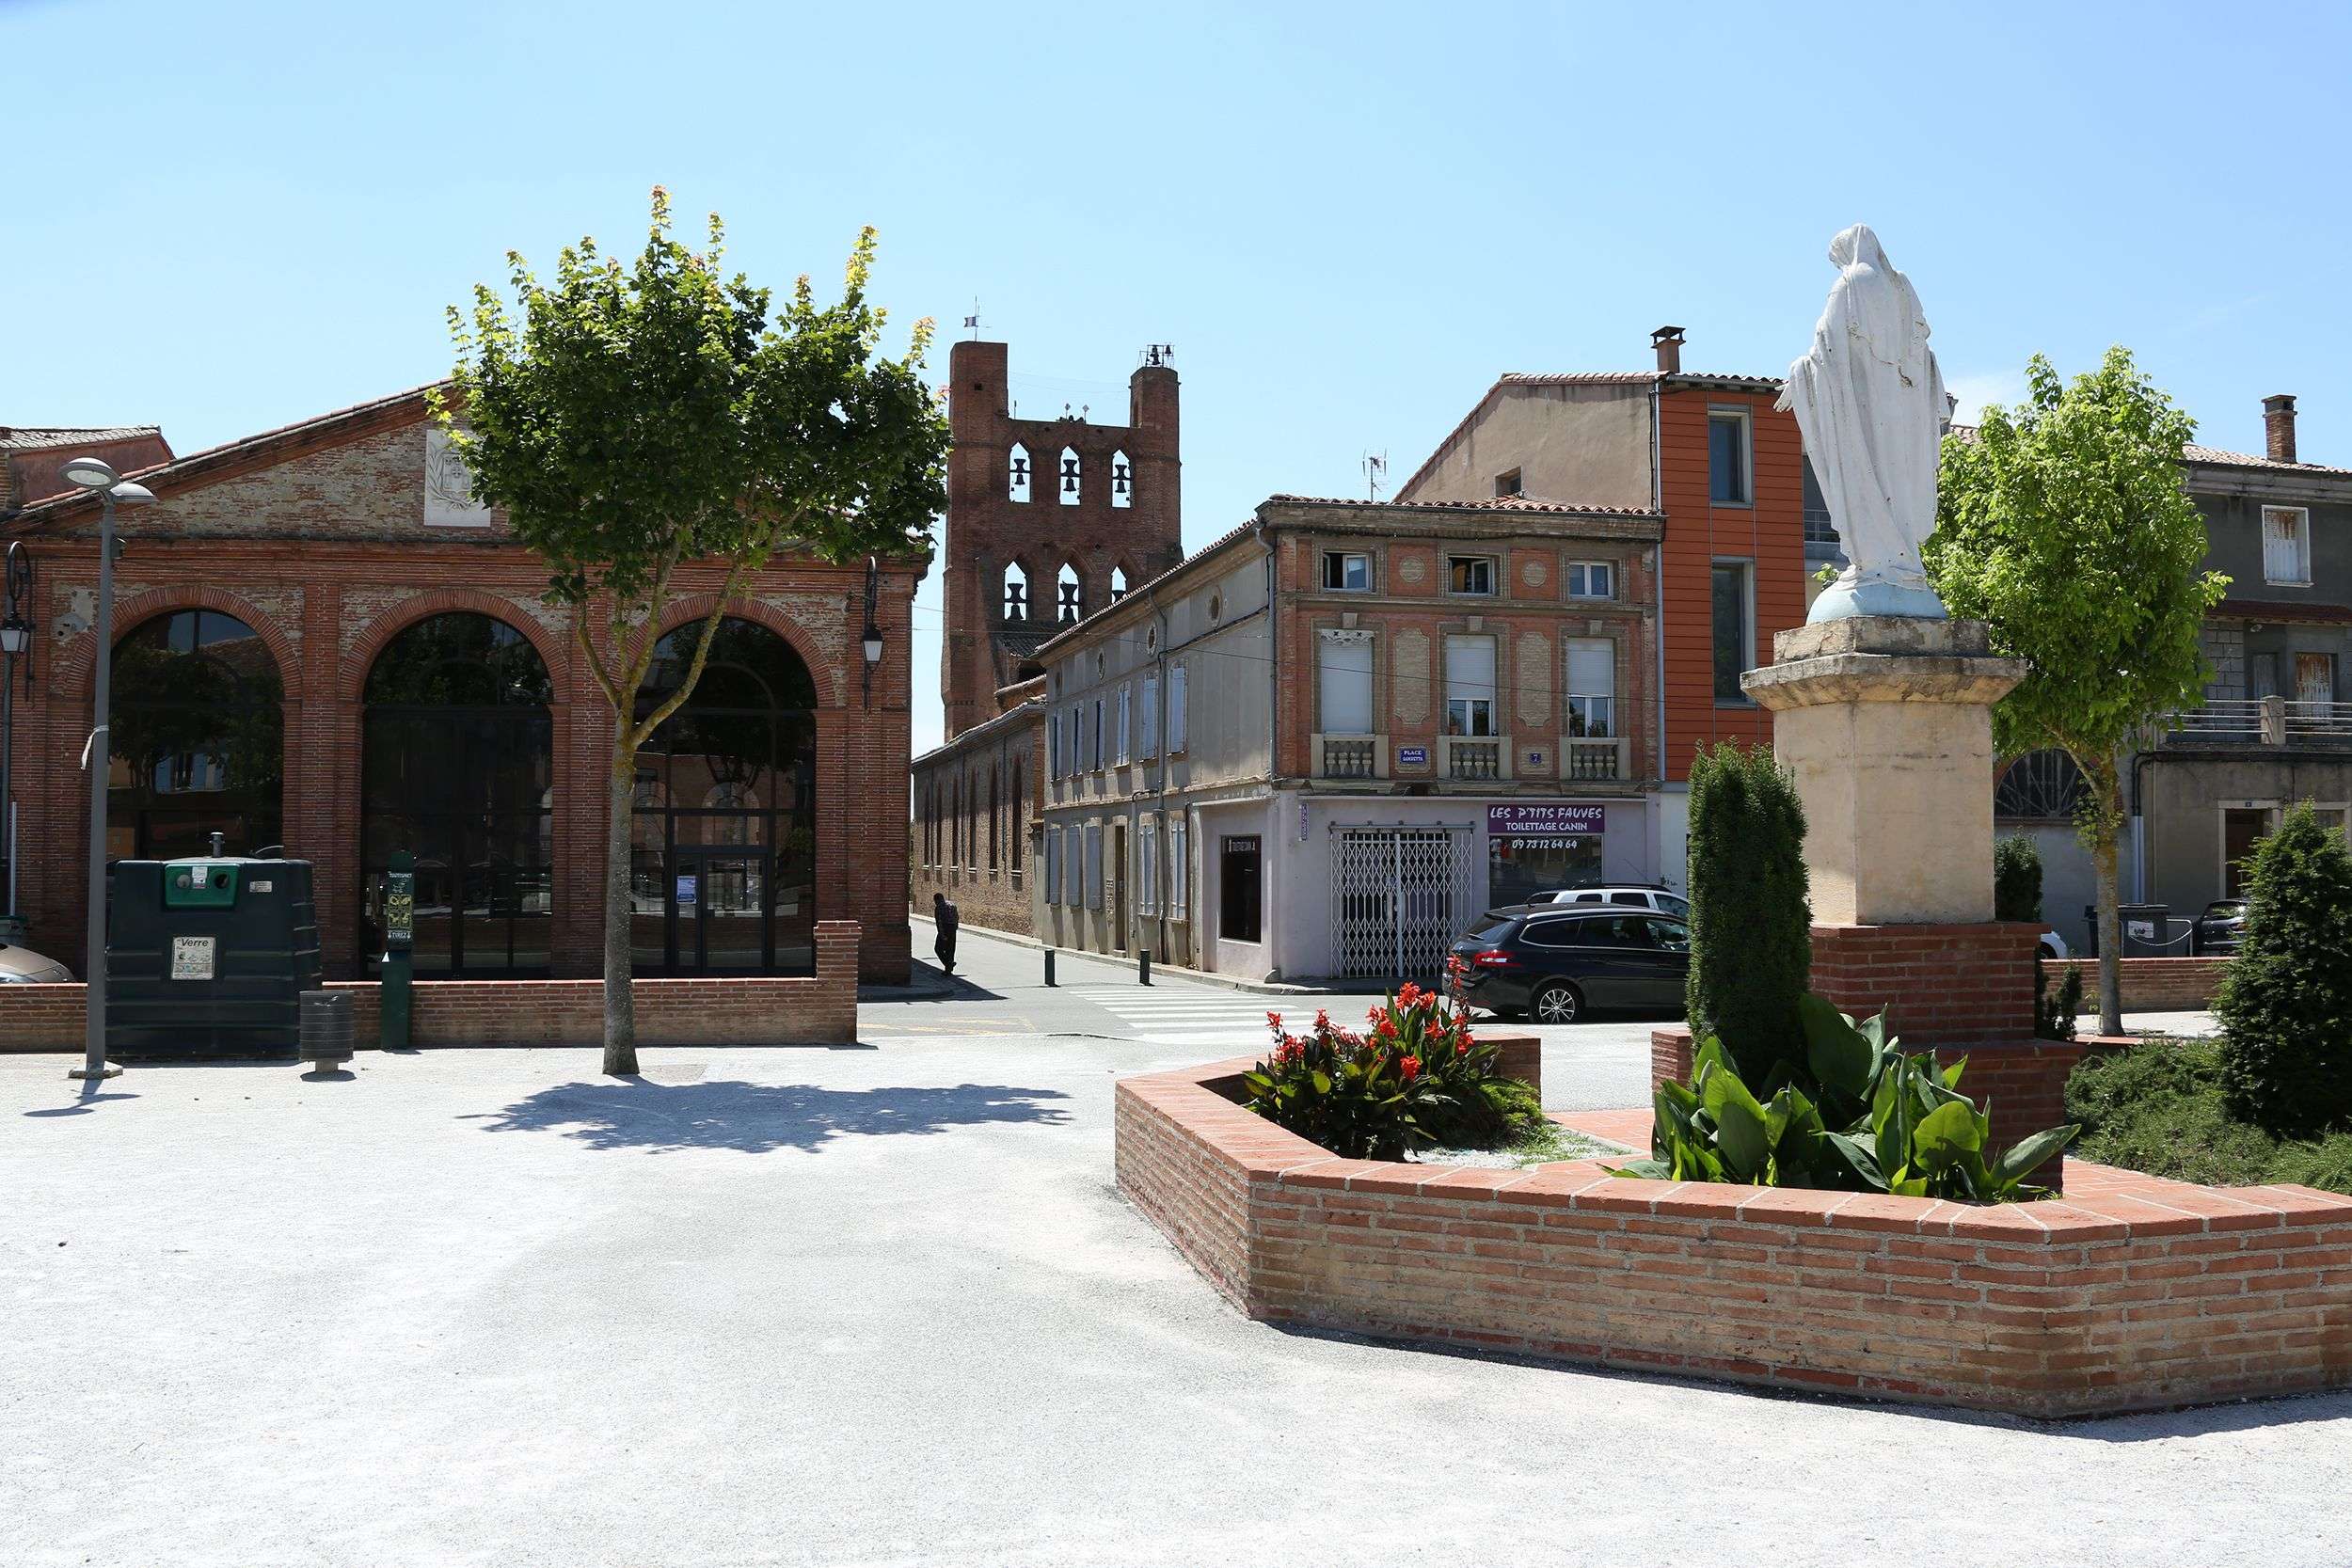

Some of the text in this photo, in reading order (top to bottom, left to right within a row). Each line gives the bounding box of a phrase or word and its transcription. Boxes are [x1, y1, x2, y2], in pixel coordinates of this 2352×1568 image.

[1534, 753, 1538, 762] 7
[1490, 807, 1602, 819] LES P'TITS FAUVES
[1505, 822, 1588, 831] TOILETTAGE CANIN
[1512, 838, 1578, 849] 09 73 12 64 64
[181, 938, 209, 946] Verre
